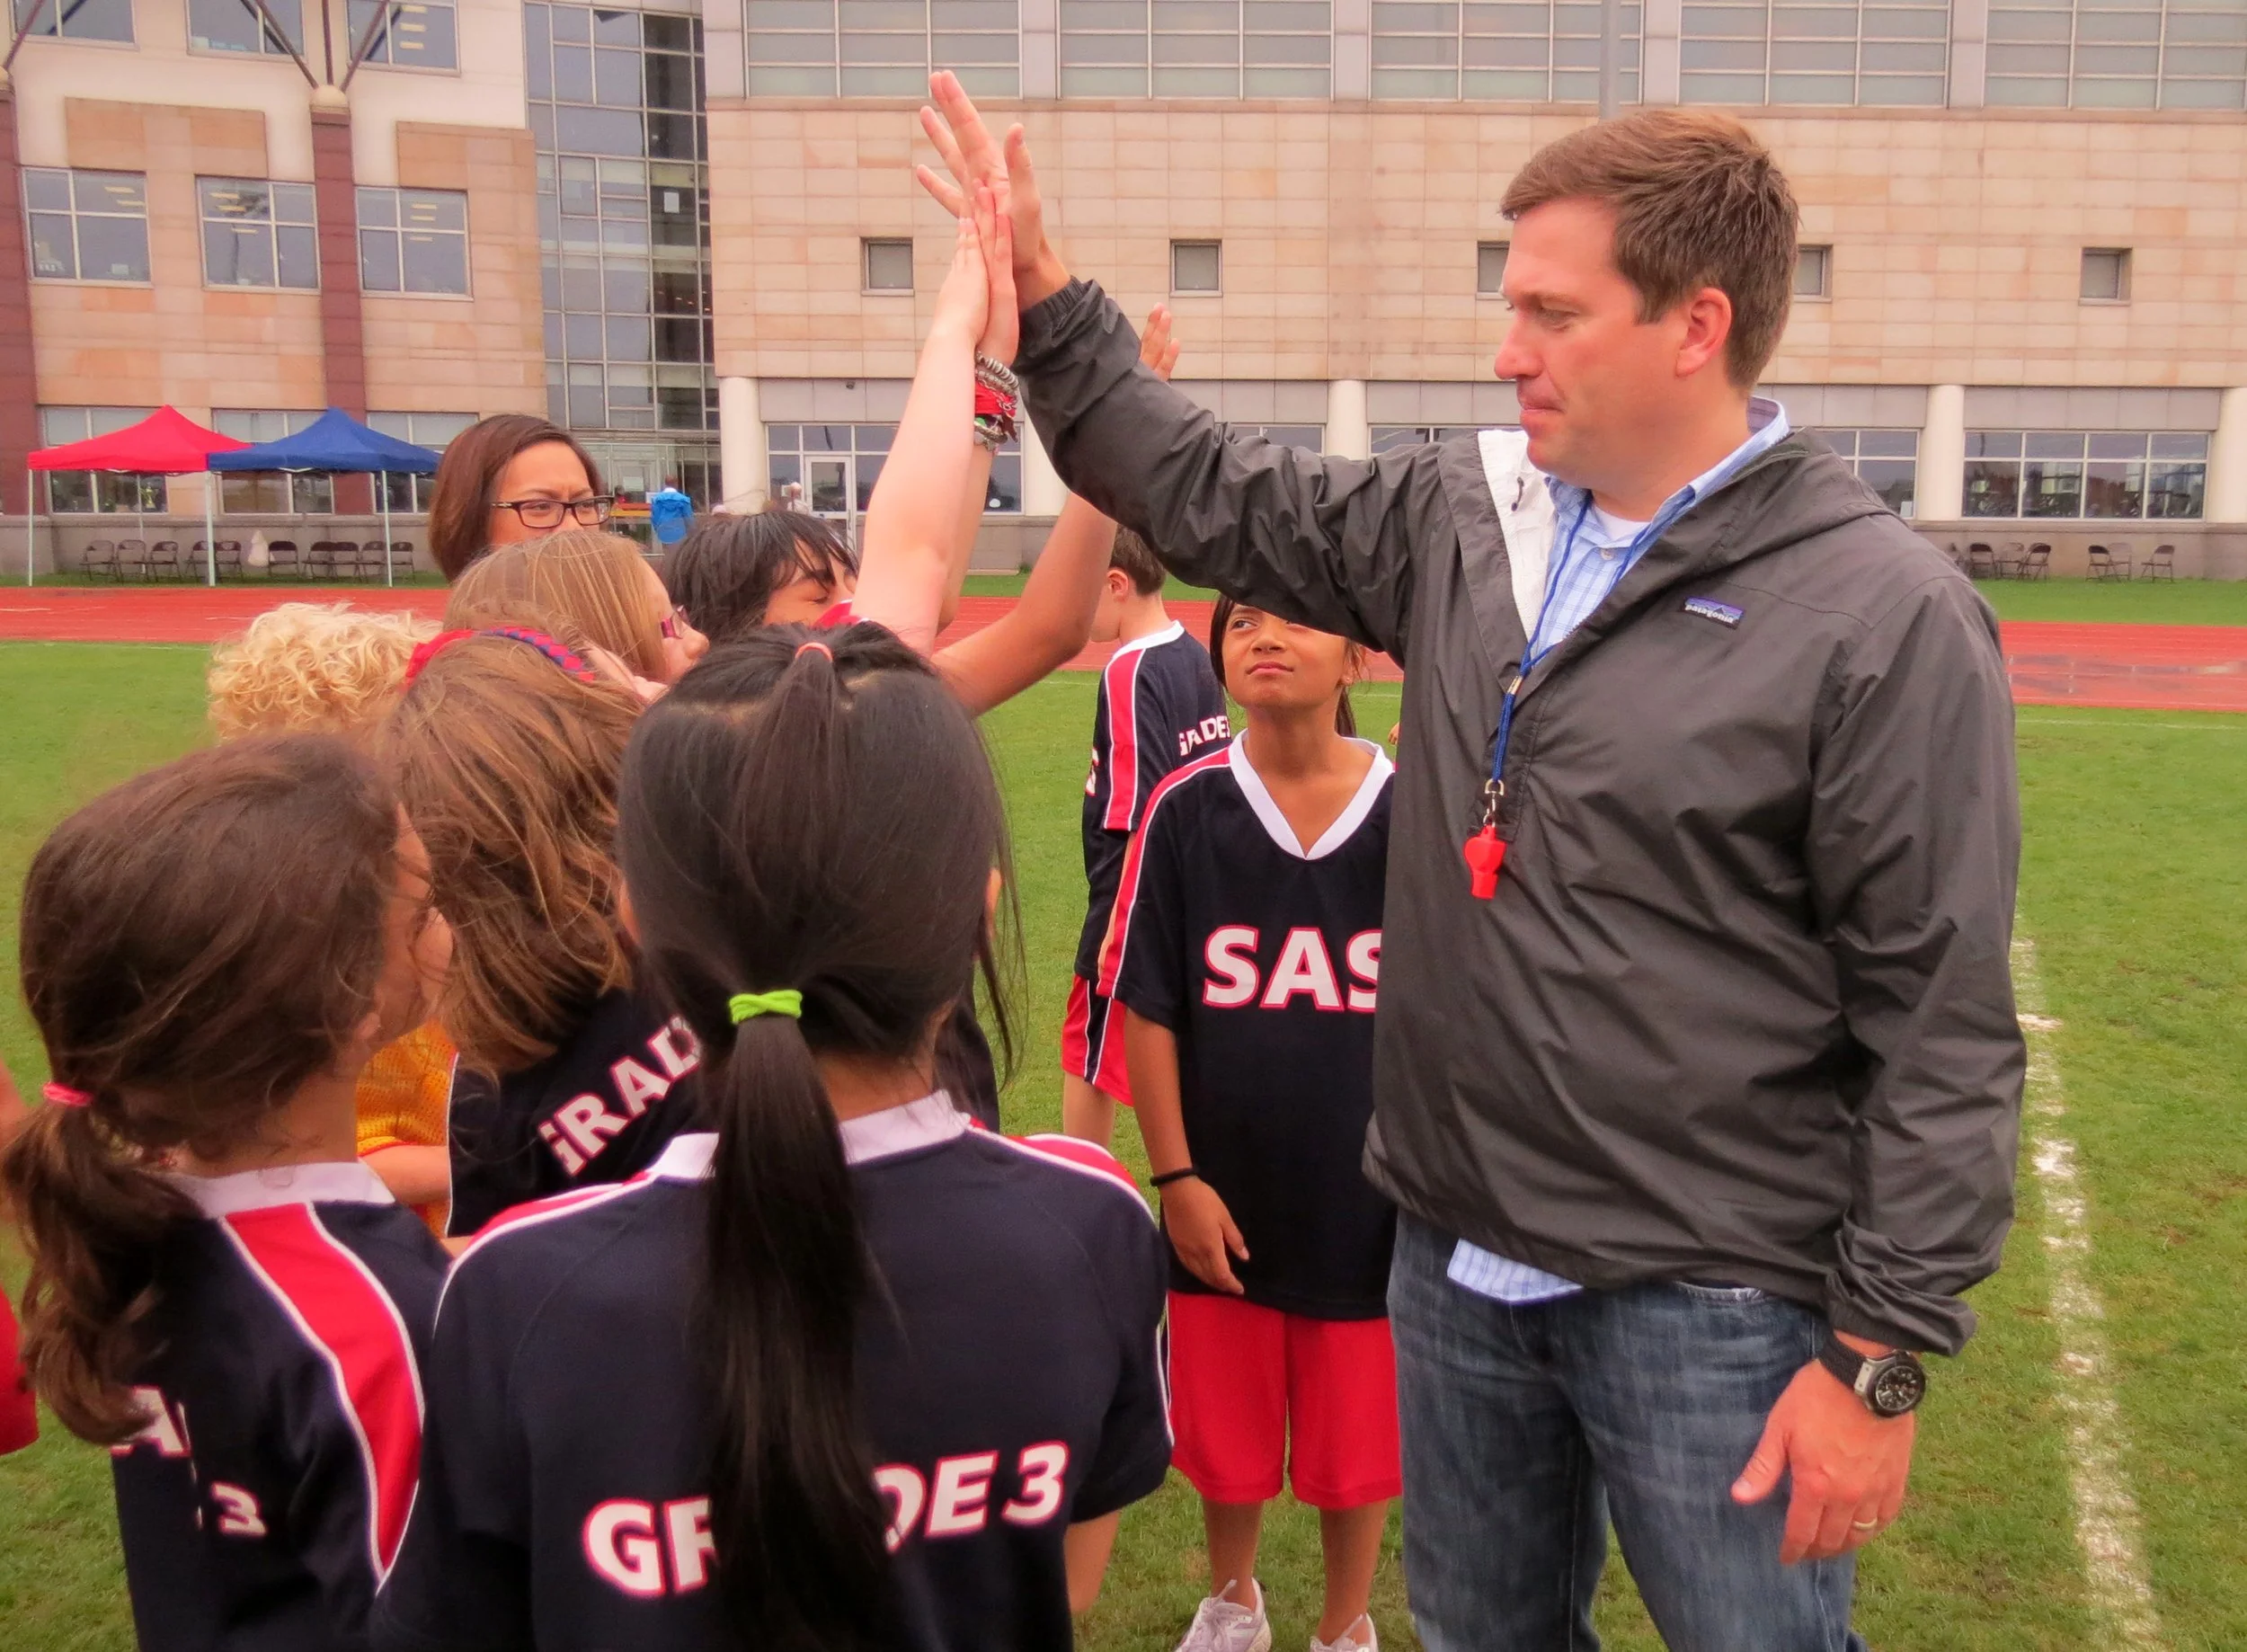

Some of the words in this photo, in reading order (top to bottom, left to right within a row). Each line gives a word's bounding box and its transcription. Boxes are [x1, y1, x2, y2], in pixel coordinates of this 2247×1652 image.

[1685, 604, 1736, 624] patagonia
[1203, 925, 1383, 1013] SAS
[210, 1481, 268, 1537] 3
[1000, 1440, 1070, 1524] 3
